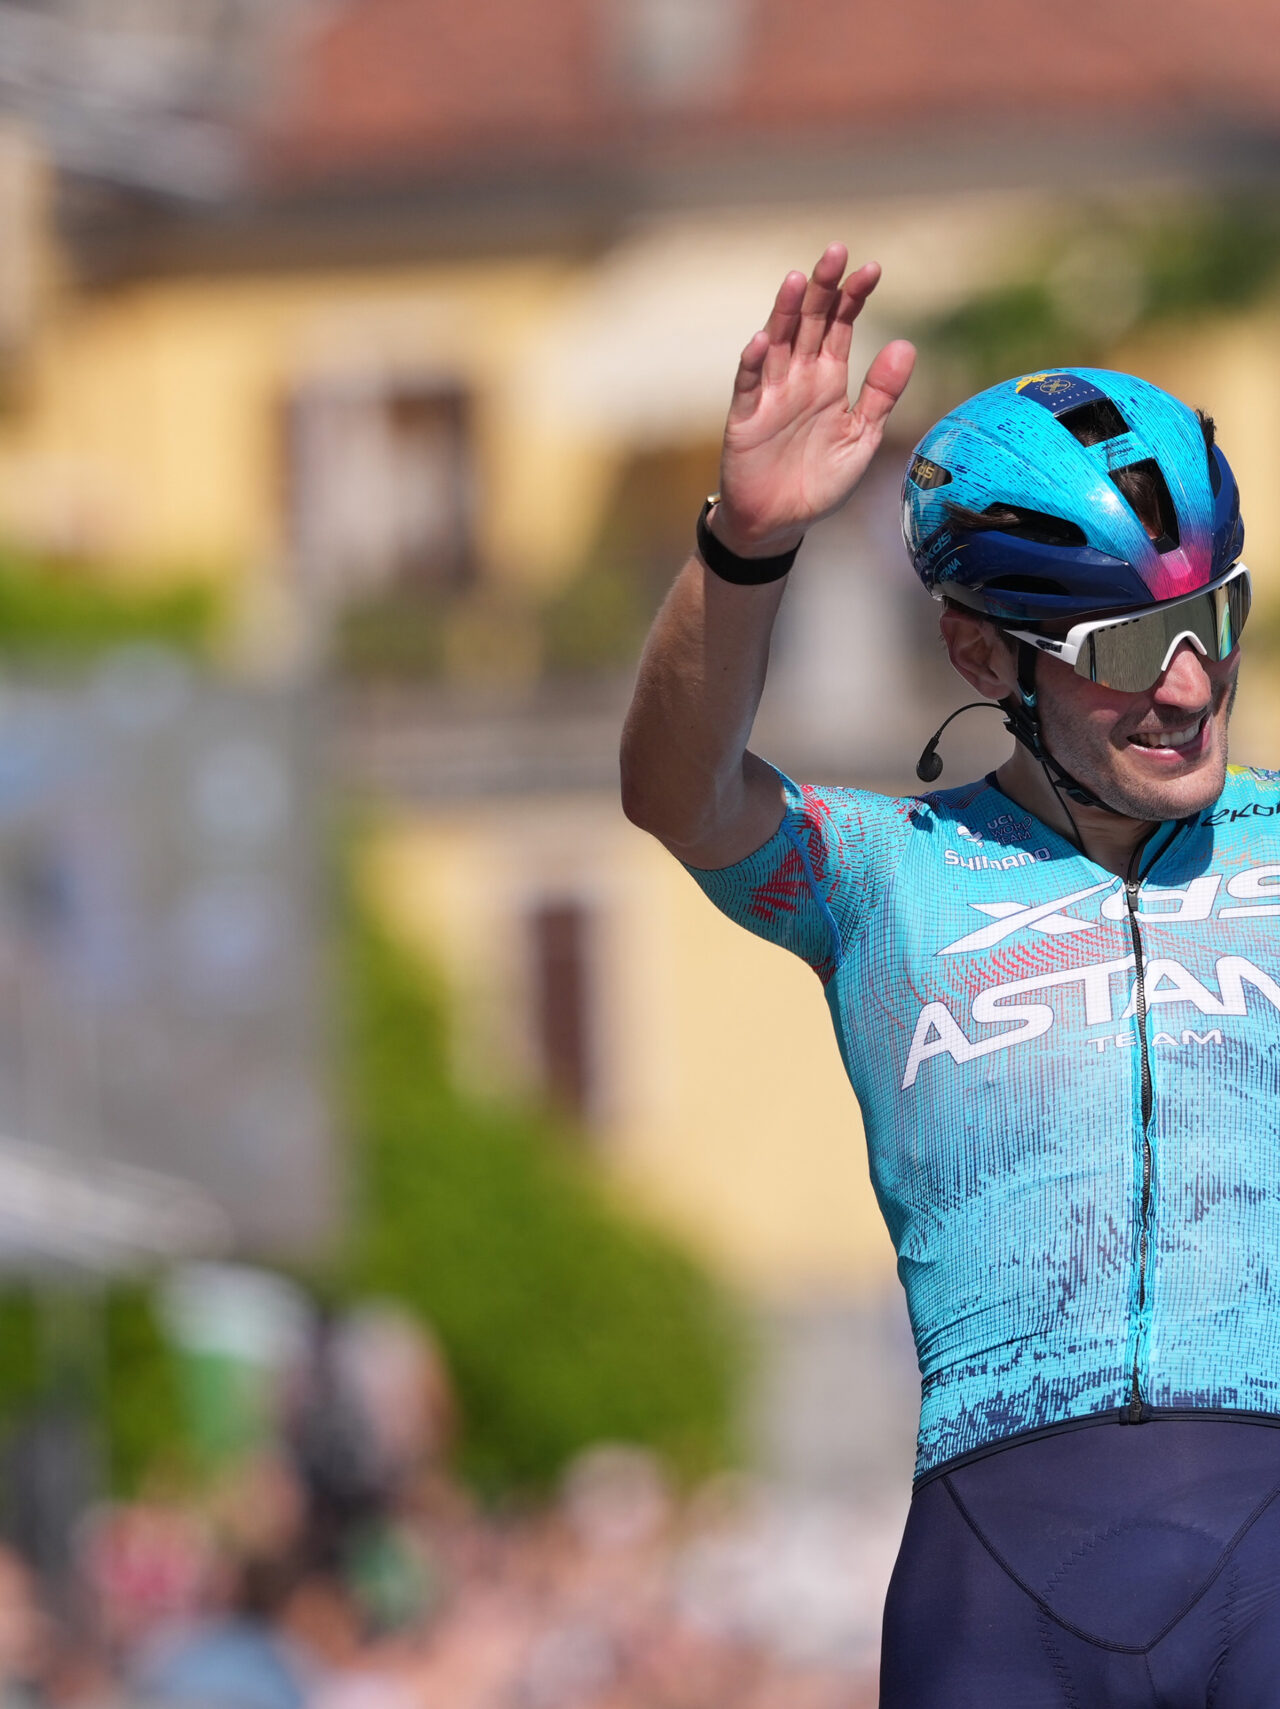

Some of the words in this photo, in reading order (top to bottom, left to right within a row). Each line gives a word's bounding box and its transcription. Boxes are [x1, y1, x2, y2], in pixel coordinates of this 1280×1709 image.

[987, 814, 1013, 829] UCI
[996, 830, 1032, 845] TEAM
[944, 848, 1051, 871] SHIMANO
[1087, 1028, 1223, 1053] TEAM
